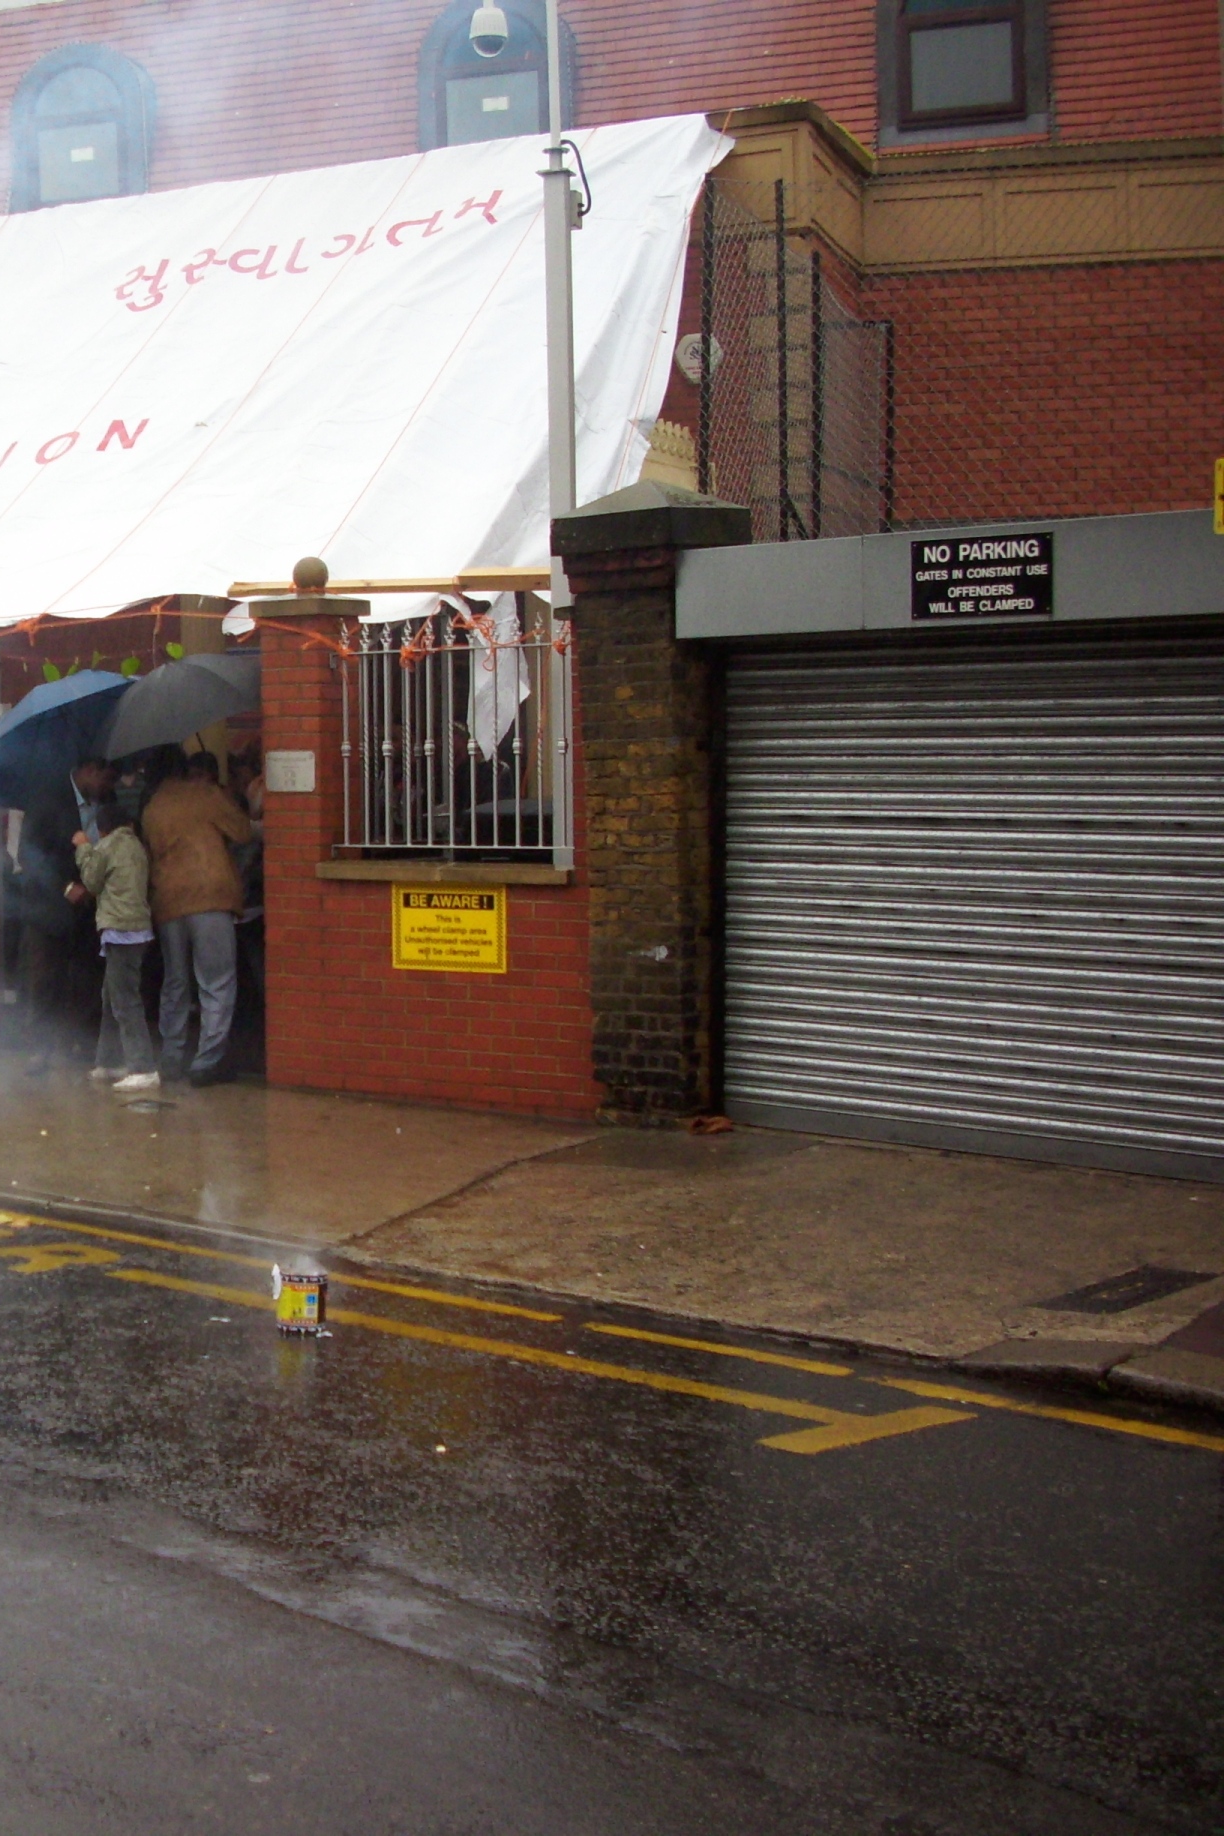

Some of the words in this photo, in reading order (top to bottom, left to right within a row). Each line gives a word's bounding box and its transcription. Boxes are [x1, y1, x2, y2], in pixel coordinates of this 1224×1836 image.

[923, 545, 951, 564] NO
[958, 539, 1040, 562] PARKING
[915, 570, 949, 582] GATES
[951, 569, 964, 580] IN
[966, 565, 1023, 580] CONSTANT
[1026, 563, 1049, 576] USE
[947, 584, 1015, 599] OFFENDERS
[928, 602, 956, 614] WILL
[959, 600, 976, 613] BE
[978, 598, 1035, 612] CLAMPED
[409, 894, 428, 907] BE
[431, 894, 480, 908] AWARE
